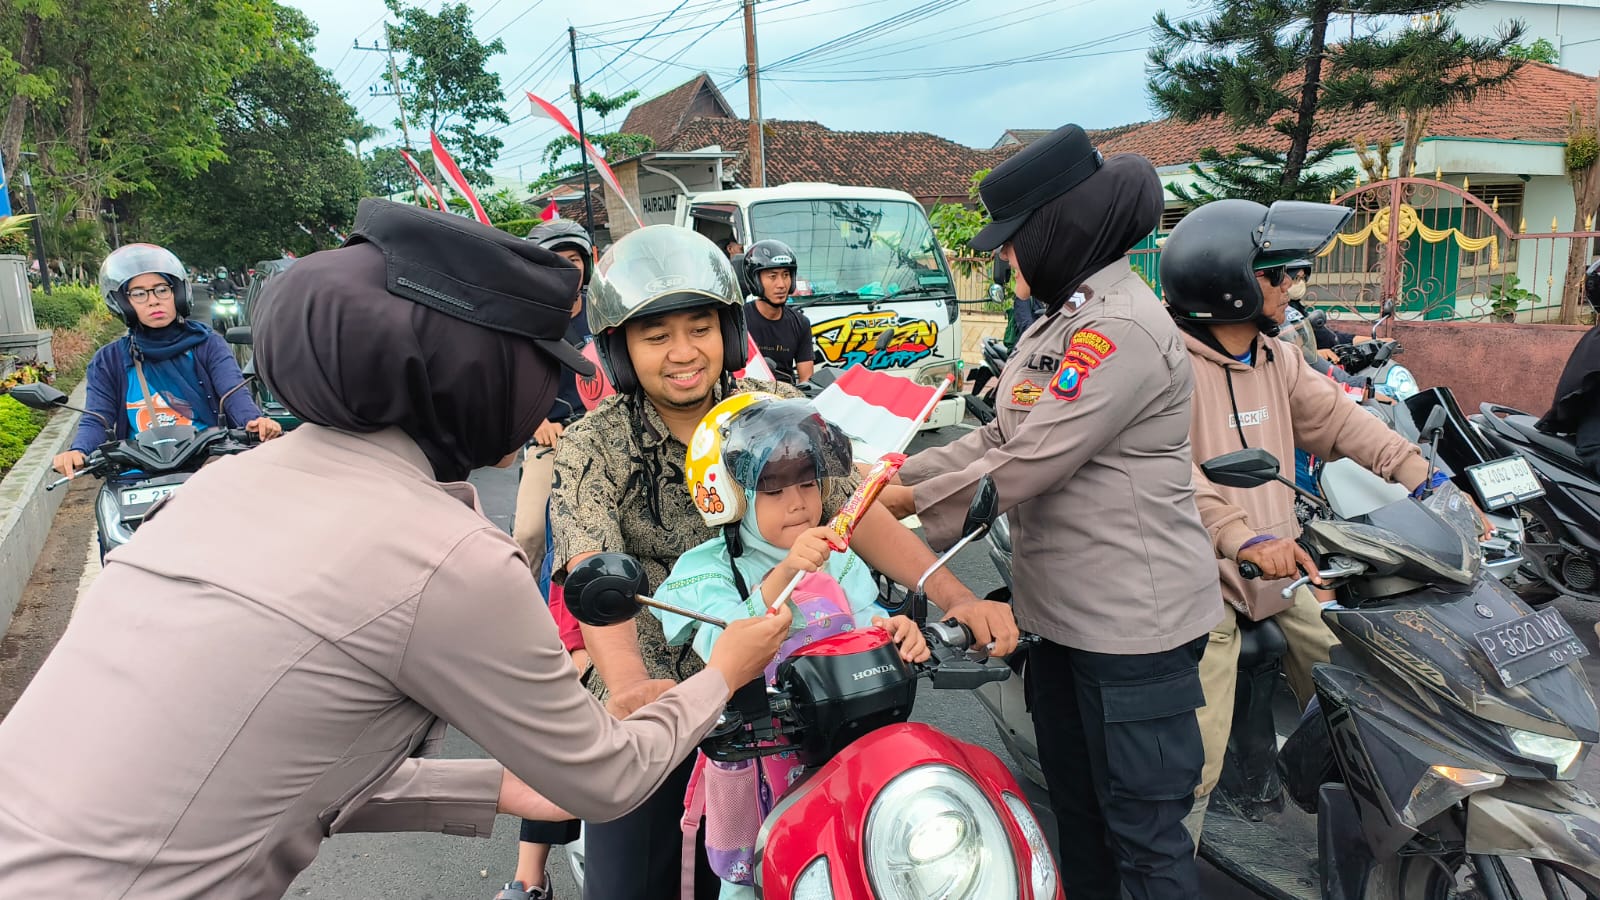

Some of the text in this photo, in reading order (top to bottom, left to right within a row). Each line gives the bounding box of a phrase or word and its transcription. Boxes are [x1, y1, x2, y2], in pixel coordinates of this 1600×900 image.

[1024, 354, 1060, 371] LRI
[129, 493, 137, 504] P
[1482, 612, 1571, 662] P 5620 WX
[852, 664, 897, 680] HONDA
